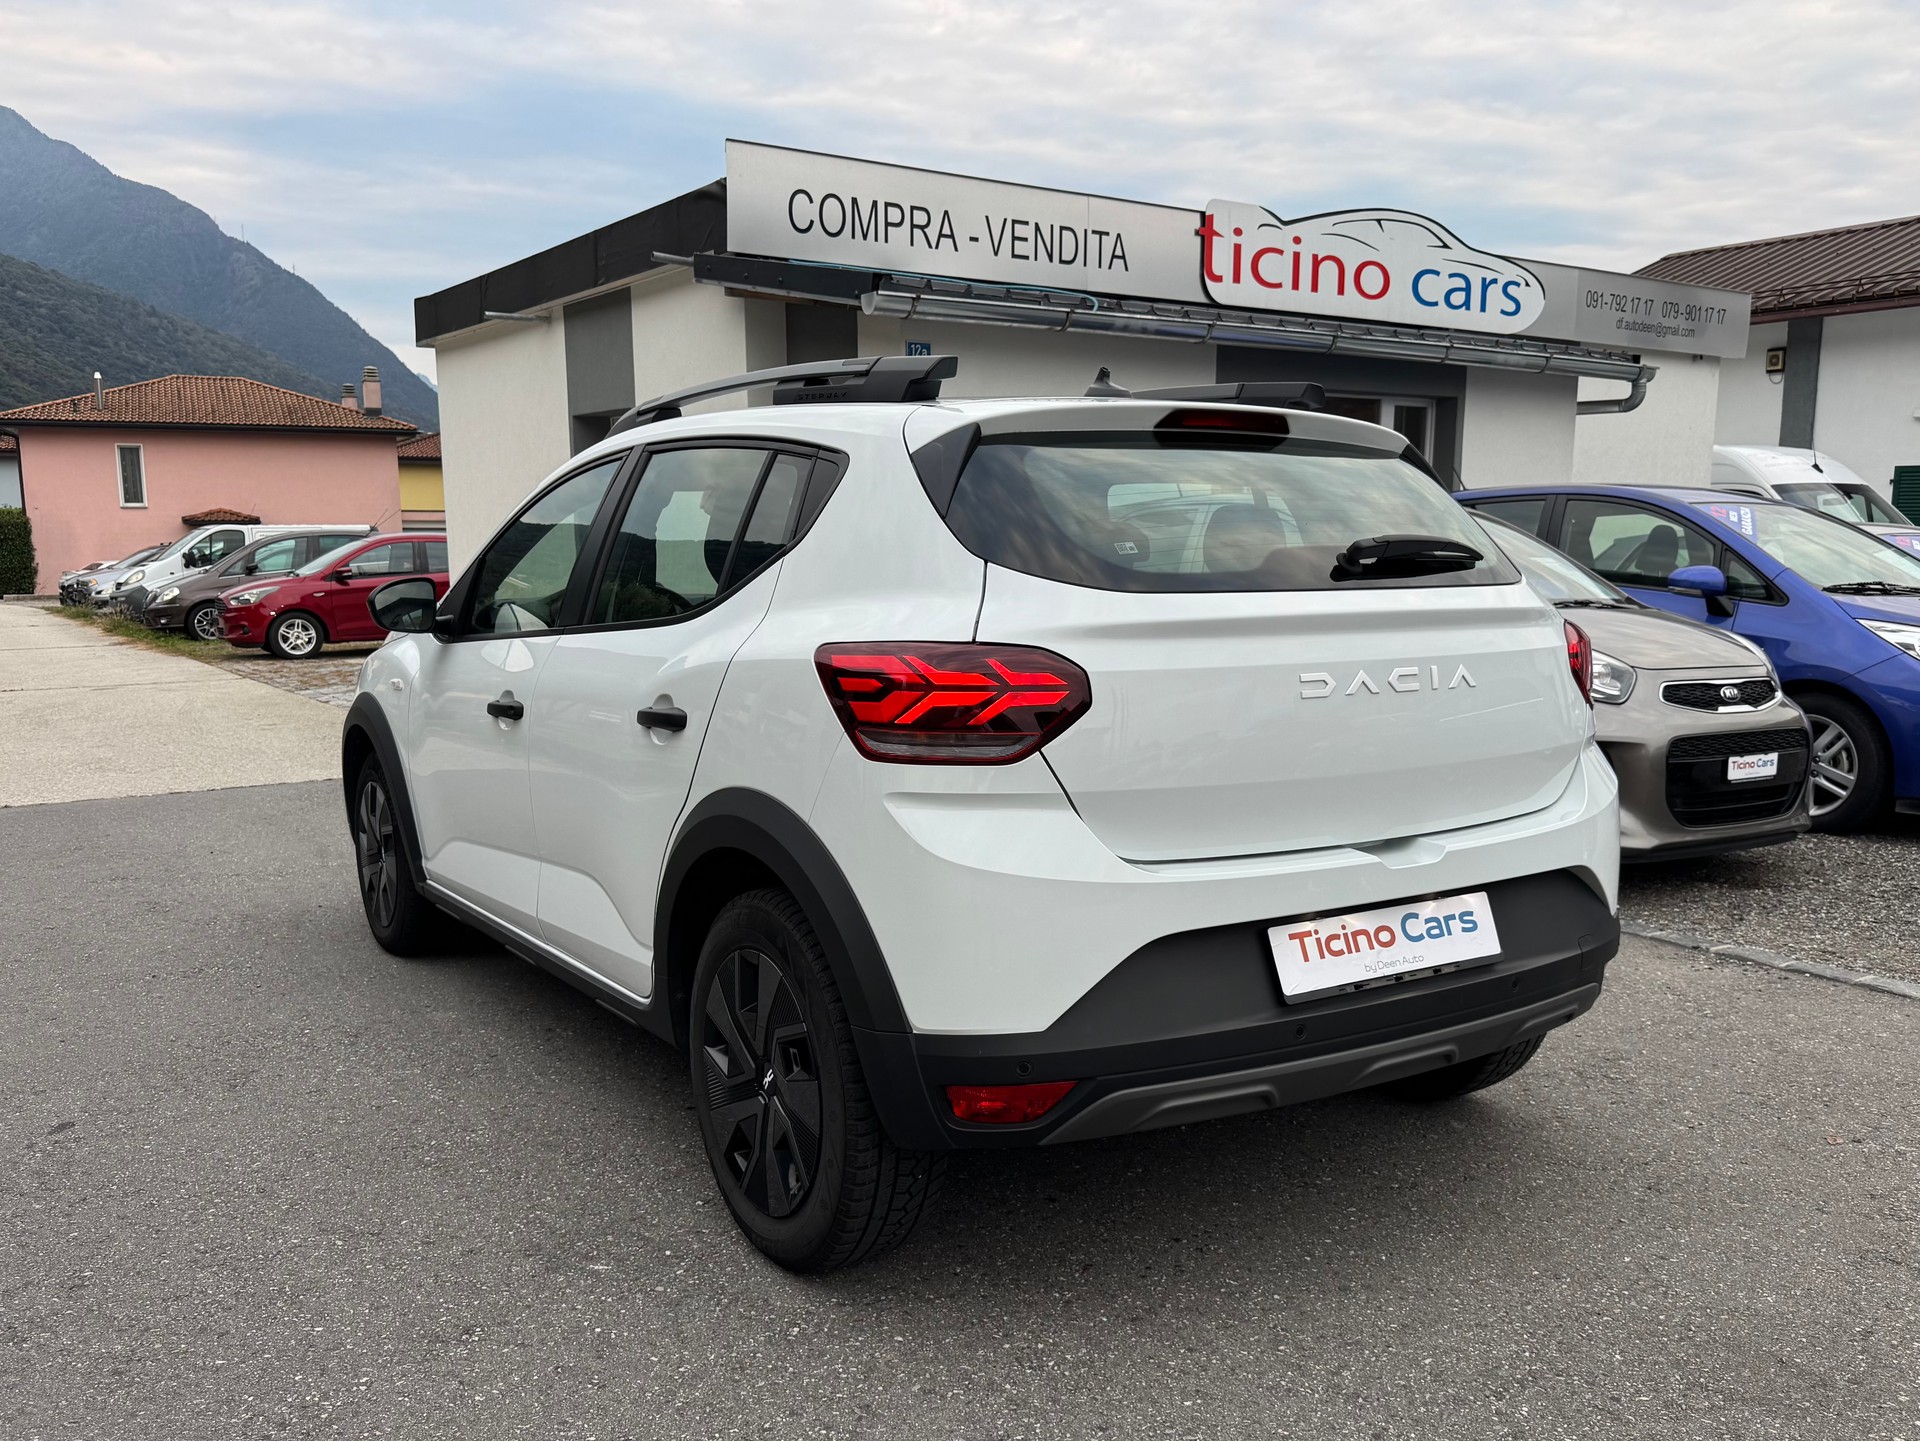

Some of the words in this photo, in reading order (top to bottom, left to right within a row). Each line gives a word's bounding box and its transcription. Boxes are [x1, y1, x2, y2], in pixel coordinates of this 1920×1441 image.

[788, 188, 958, 252] COMPRA
[1199, 213, 1390, 300] ticino
[1411, 268, 1522, 318] cars
[1585, 289, 1628, 312] 091-792
[1299, 664, 1477, 699] DACIA
[1732, 760, 1756, 771] Ticino
[1756, 758, 1775, 768] Cars
[1288, 924, 1396, 963] Ticino
[1400, 910, 1479, 943] Cars
[1364, 963, 1378, 973] by
[1377, 959, 1402, 970] Deen
[1402, 955, 1425, 965] Auto
